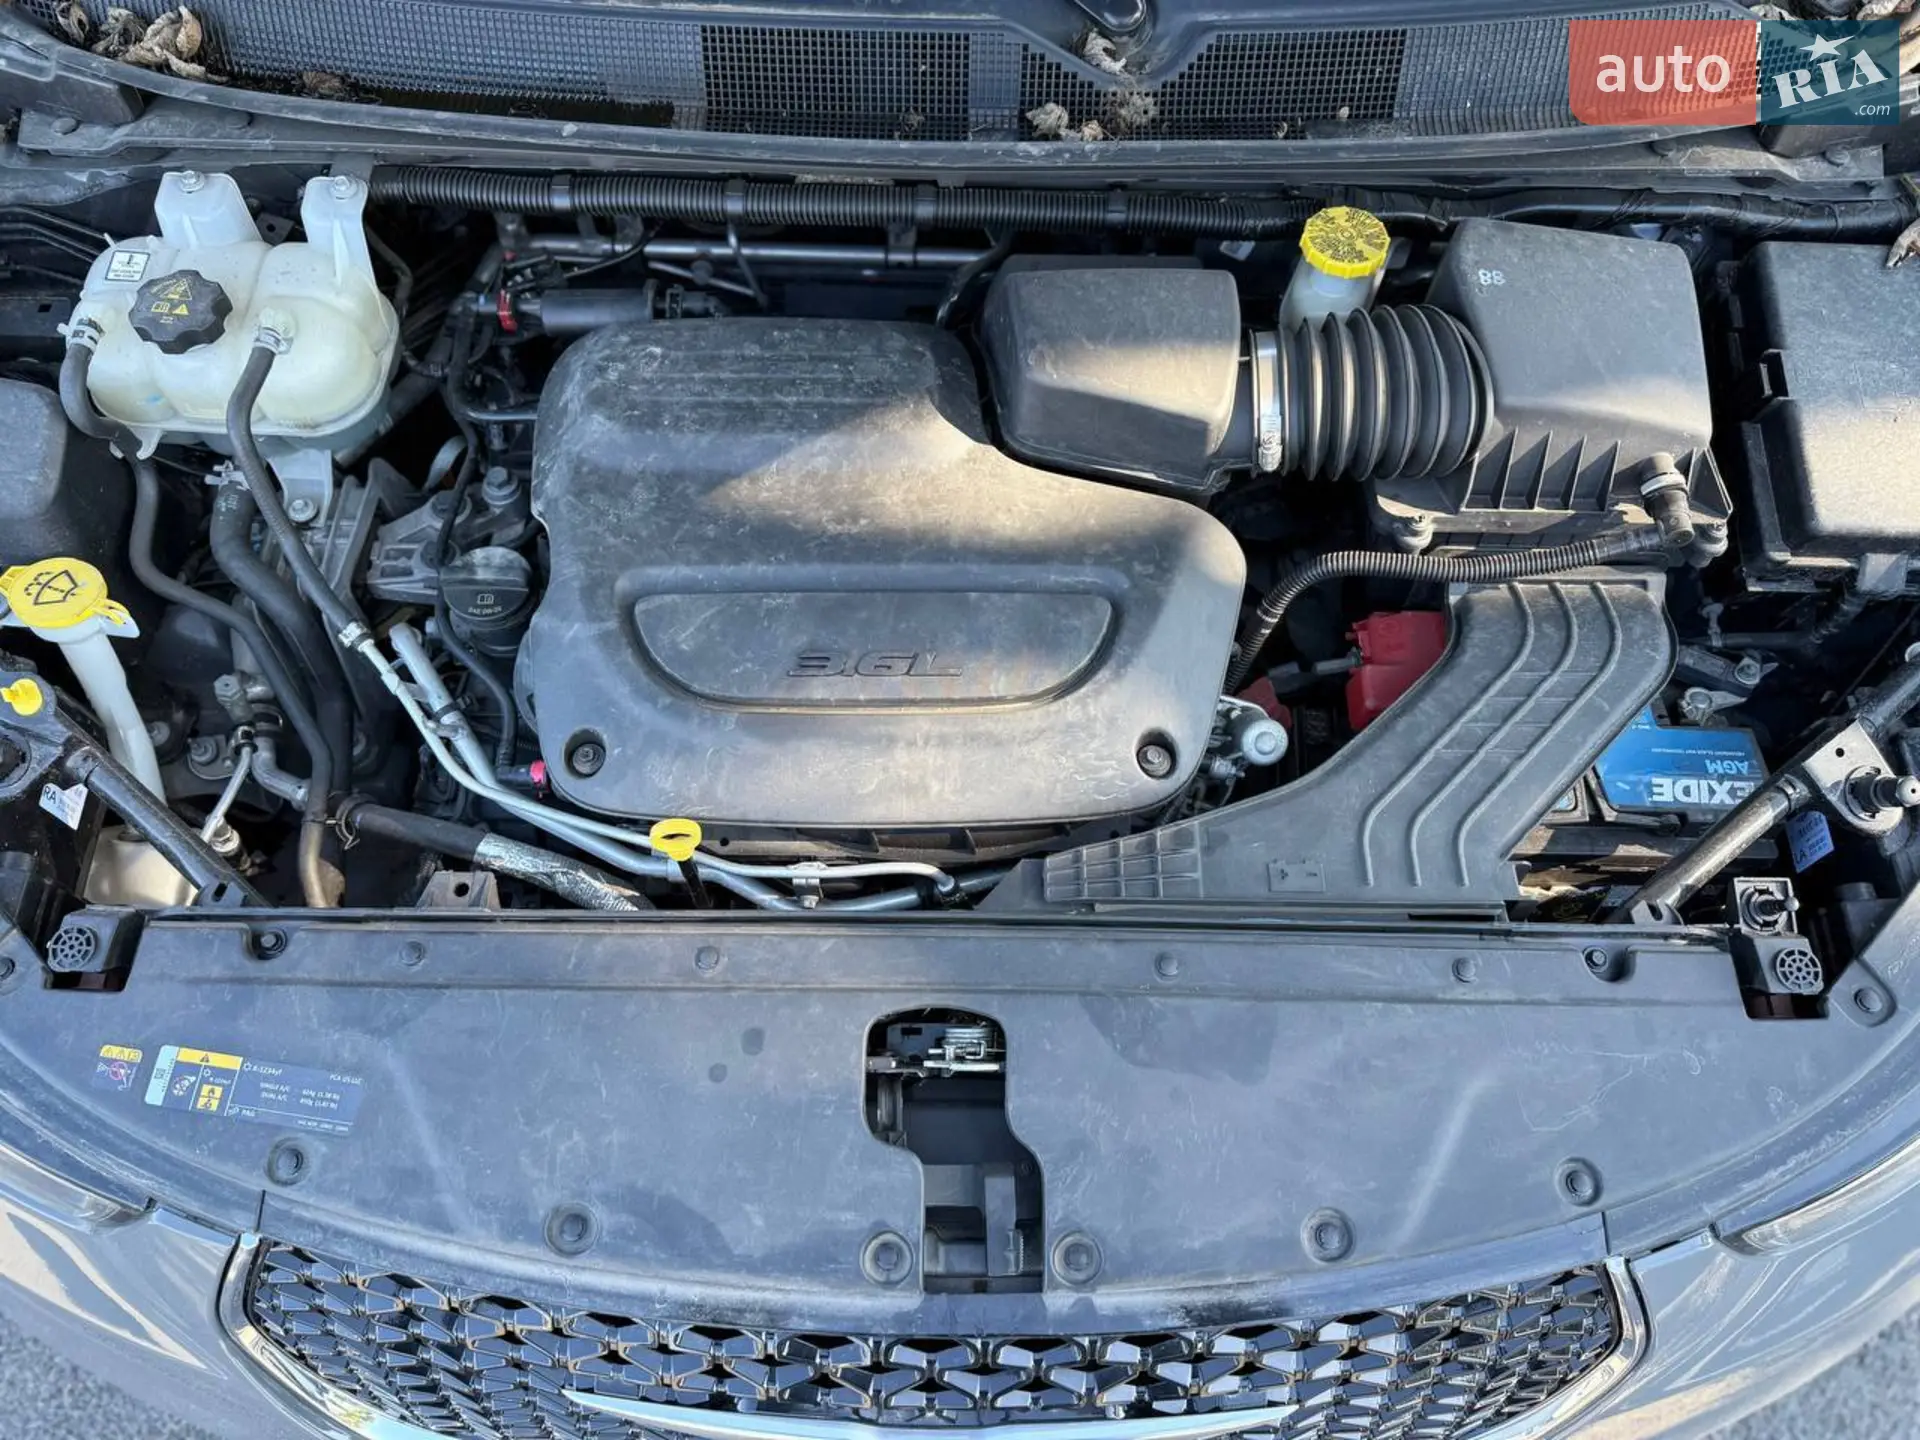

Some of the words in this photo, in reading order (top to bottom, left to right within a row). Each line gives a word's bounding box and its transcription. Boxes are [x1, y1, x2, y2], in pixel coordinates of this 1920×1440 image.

[788, 651, 963, 677] 3.6L
[1704, 759, 1749, 776] AGM
[1651, 777, 1755, 805] EXIDE
